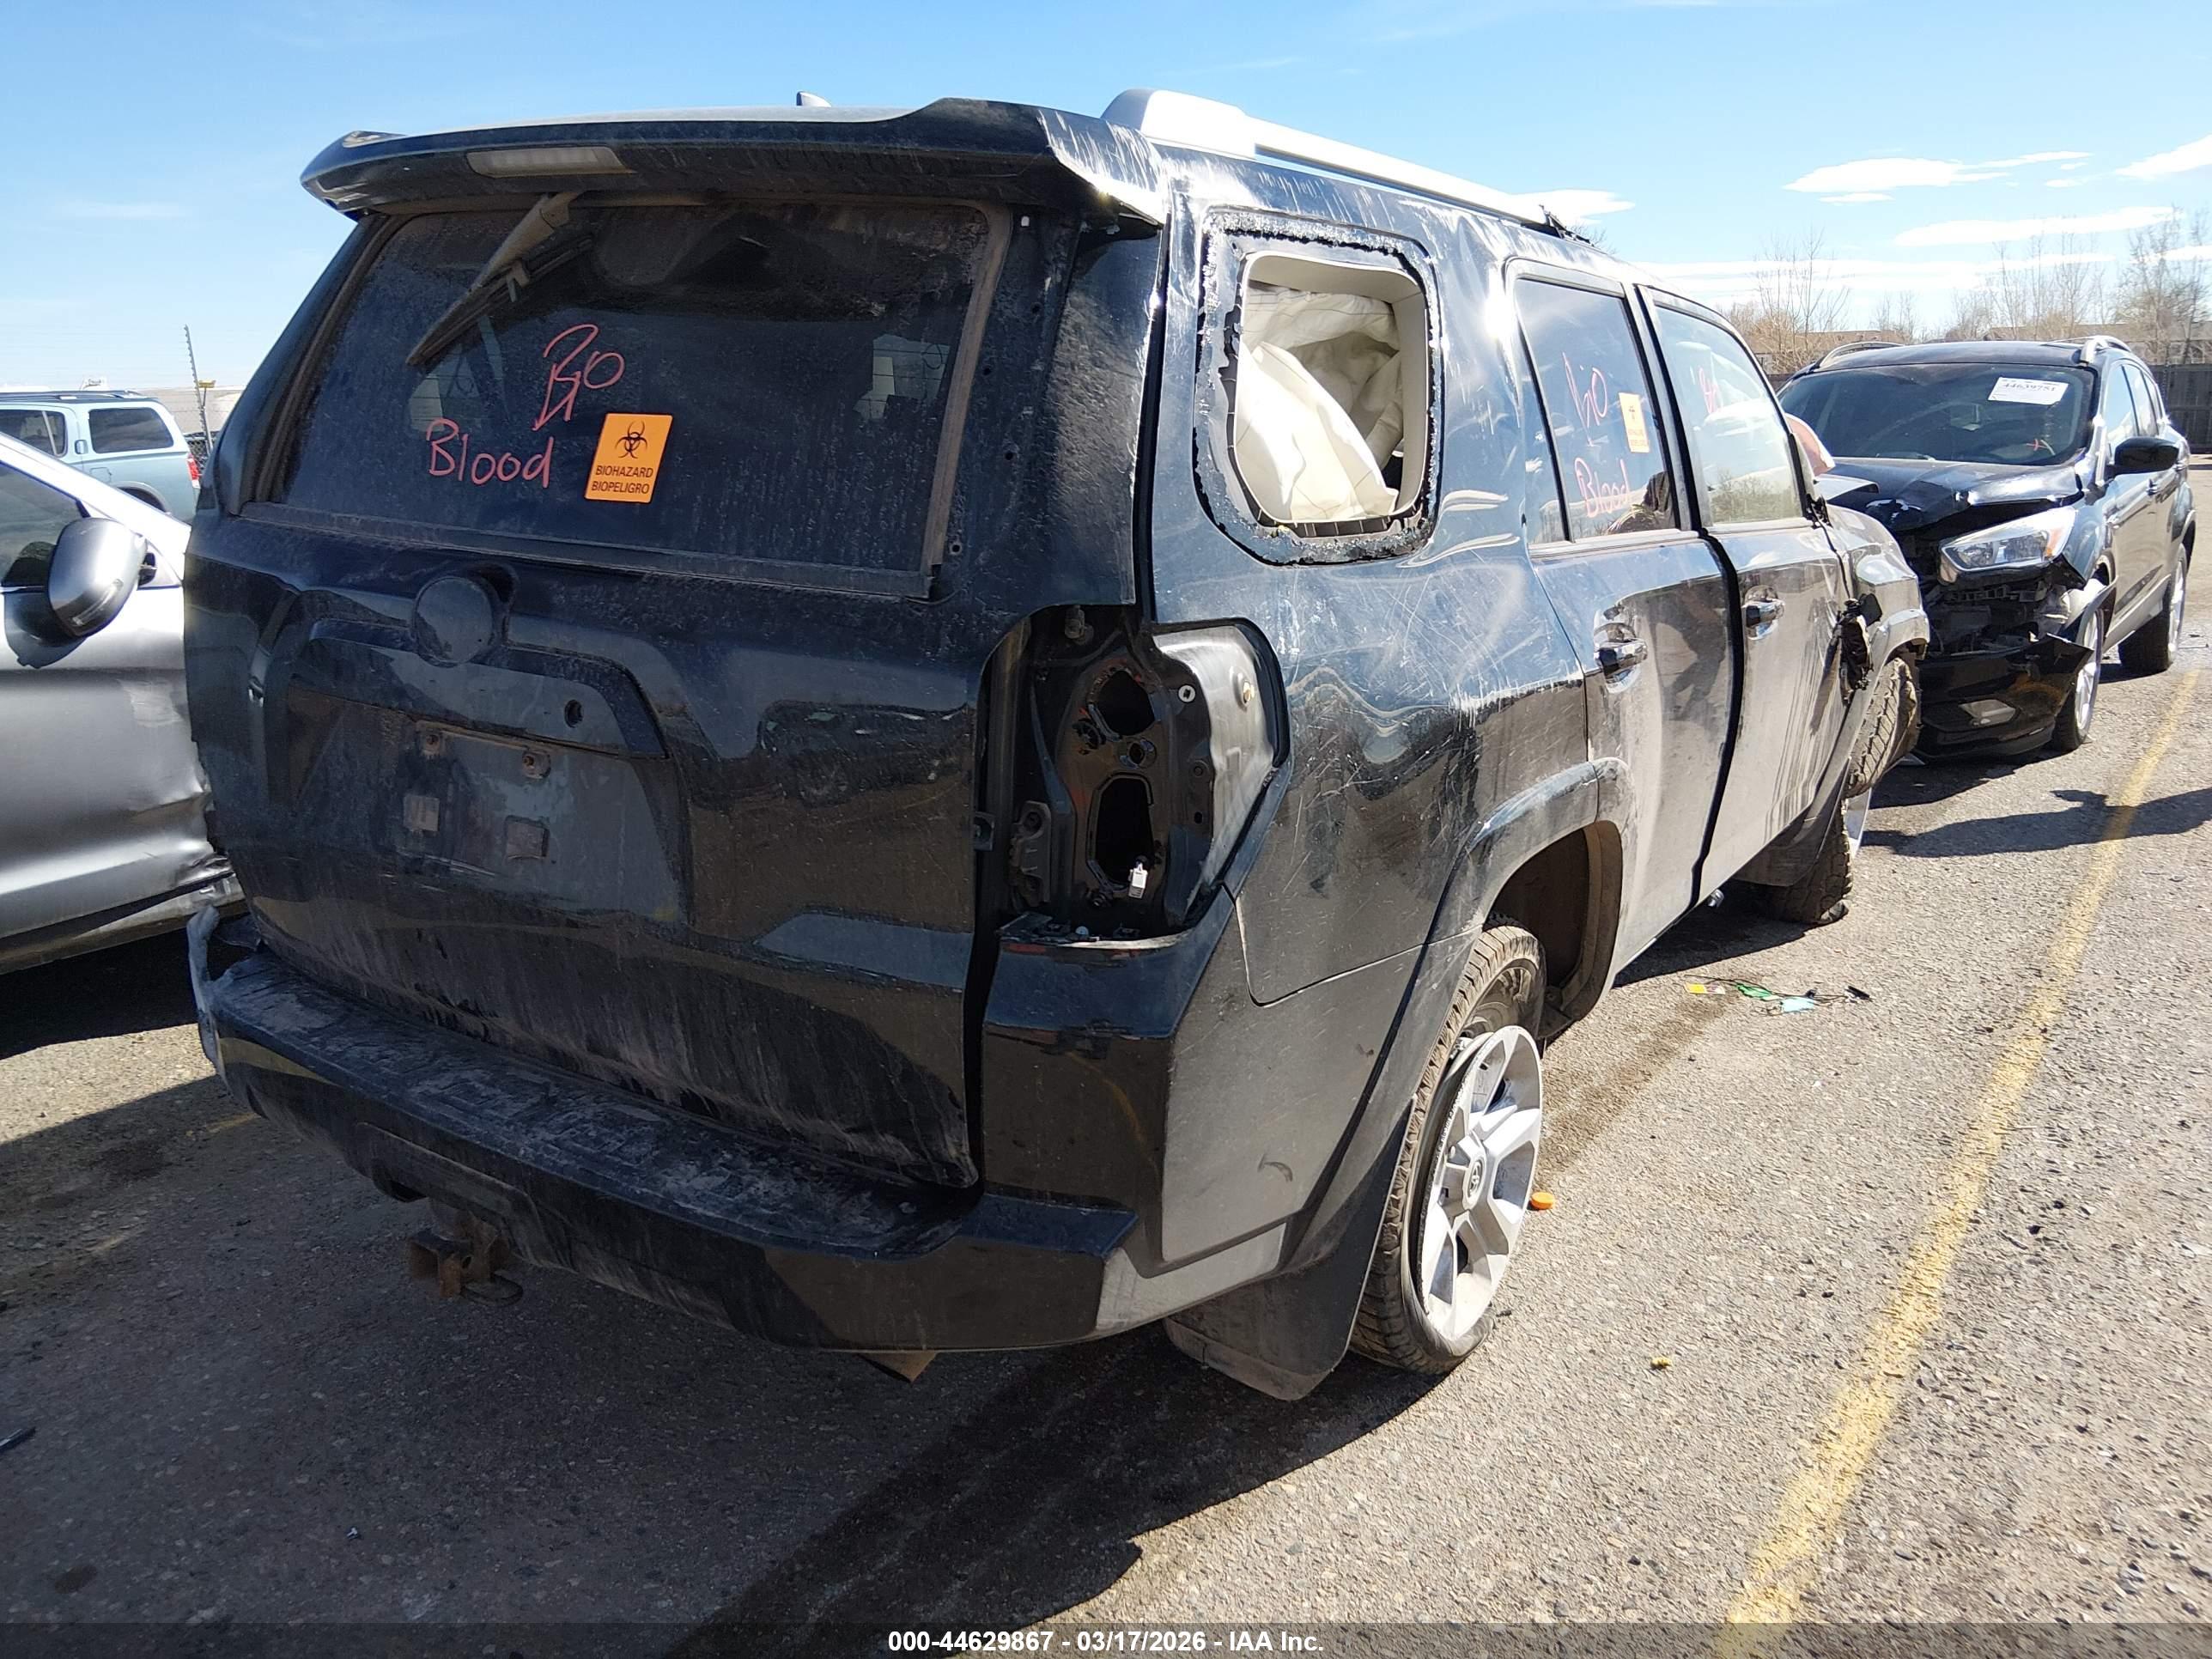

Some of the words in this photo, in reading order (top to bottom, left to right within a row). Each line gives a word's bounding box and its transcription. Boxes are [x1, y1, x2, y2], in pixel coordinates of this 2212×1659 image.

[426, 418, 554, 488] Blood
[596, 465, 653, 477] BIOHAZARD
[592, 481, 650, 494] BIOPELIGRO
[1574, 458, 1630, 518] Blood
